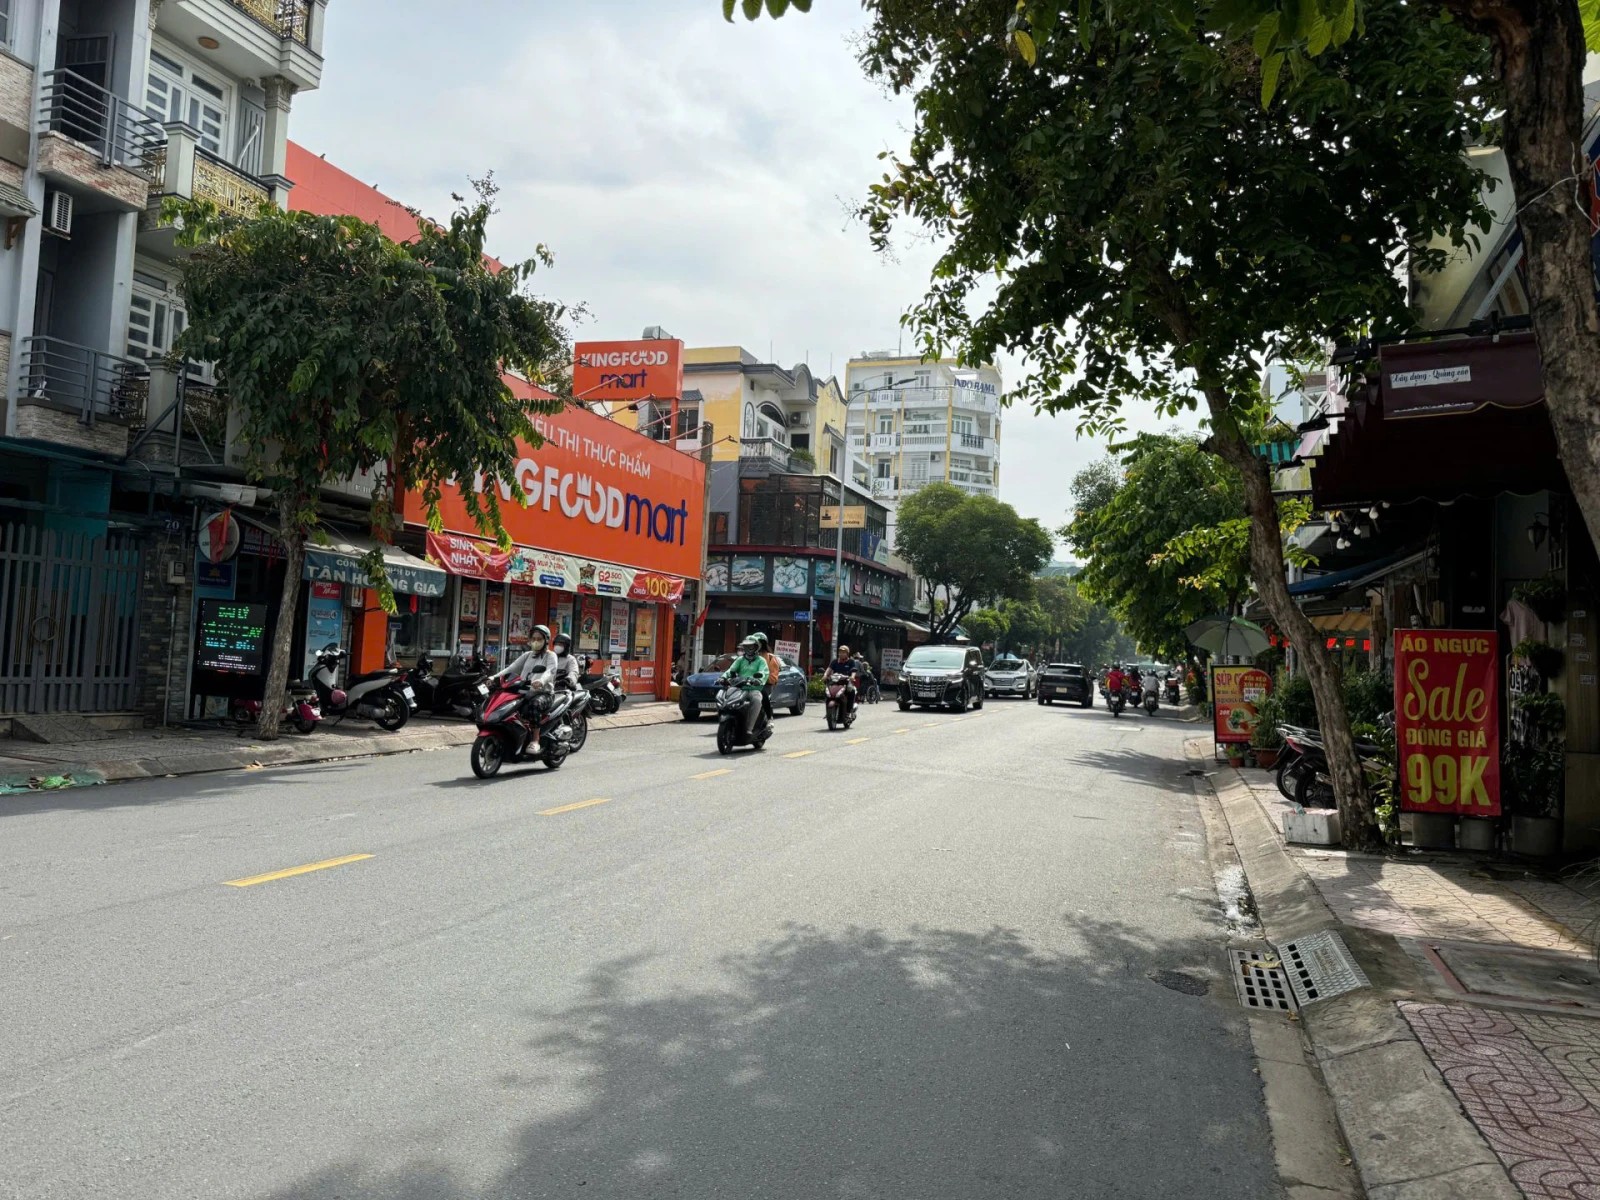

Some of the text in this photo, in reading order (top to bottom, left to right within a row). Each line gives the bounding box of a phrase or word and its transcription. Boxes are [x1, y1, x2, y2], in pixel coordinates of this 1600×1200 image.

[580, 349, 669, 368] KINGFOOD
[600, 368, 648, 389] mart
[557, 427, 580, 457] THỊ
[583, 437, 616, 468] THỰC
[619, 451, 651, 480] PHẨM
[164, 518, 180, 531] 70
[451, 552, 480, 568] NHẬT
[307, 565, 438, 594] TÂN HONG GIA
[1400, 634, 1490, 657] ÁO NGỰC
[1403, 658, 1489, 723] Sale
[1405, 722, 1488, 748] ĐỒNG GIÁ
[1406, 753, 1492, 807] 99K
